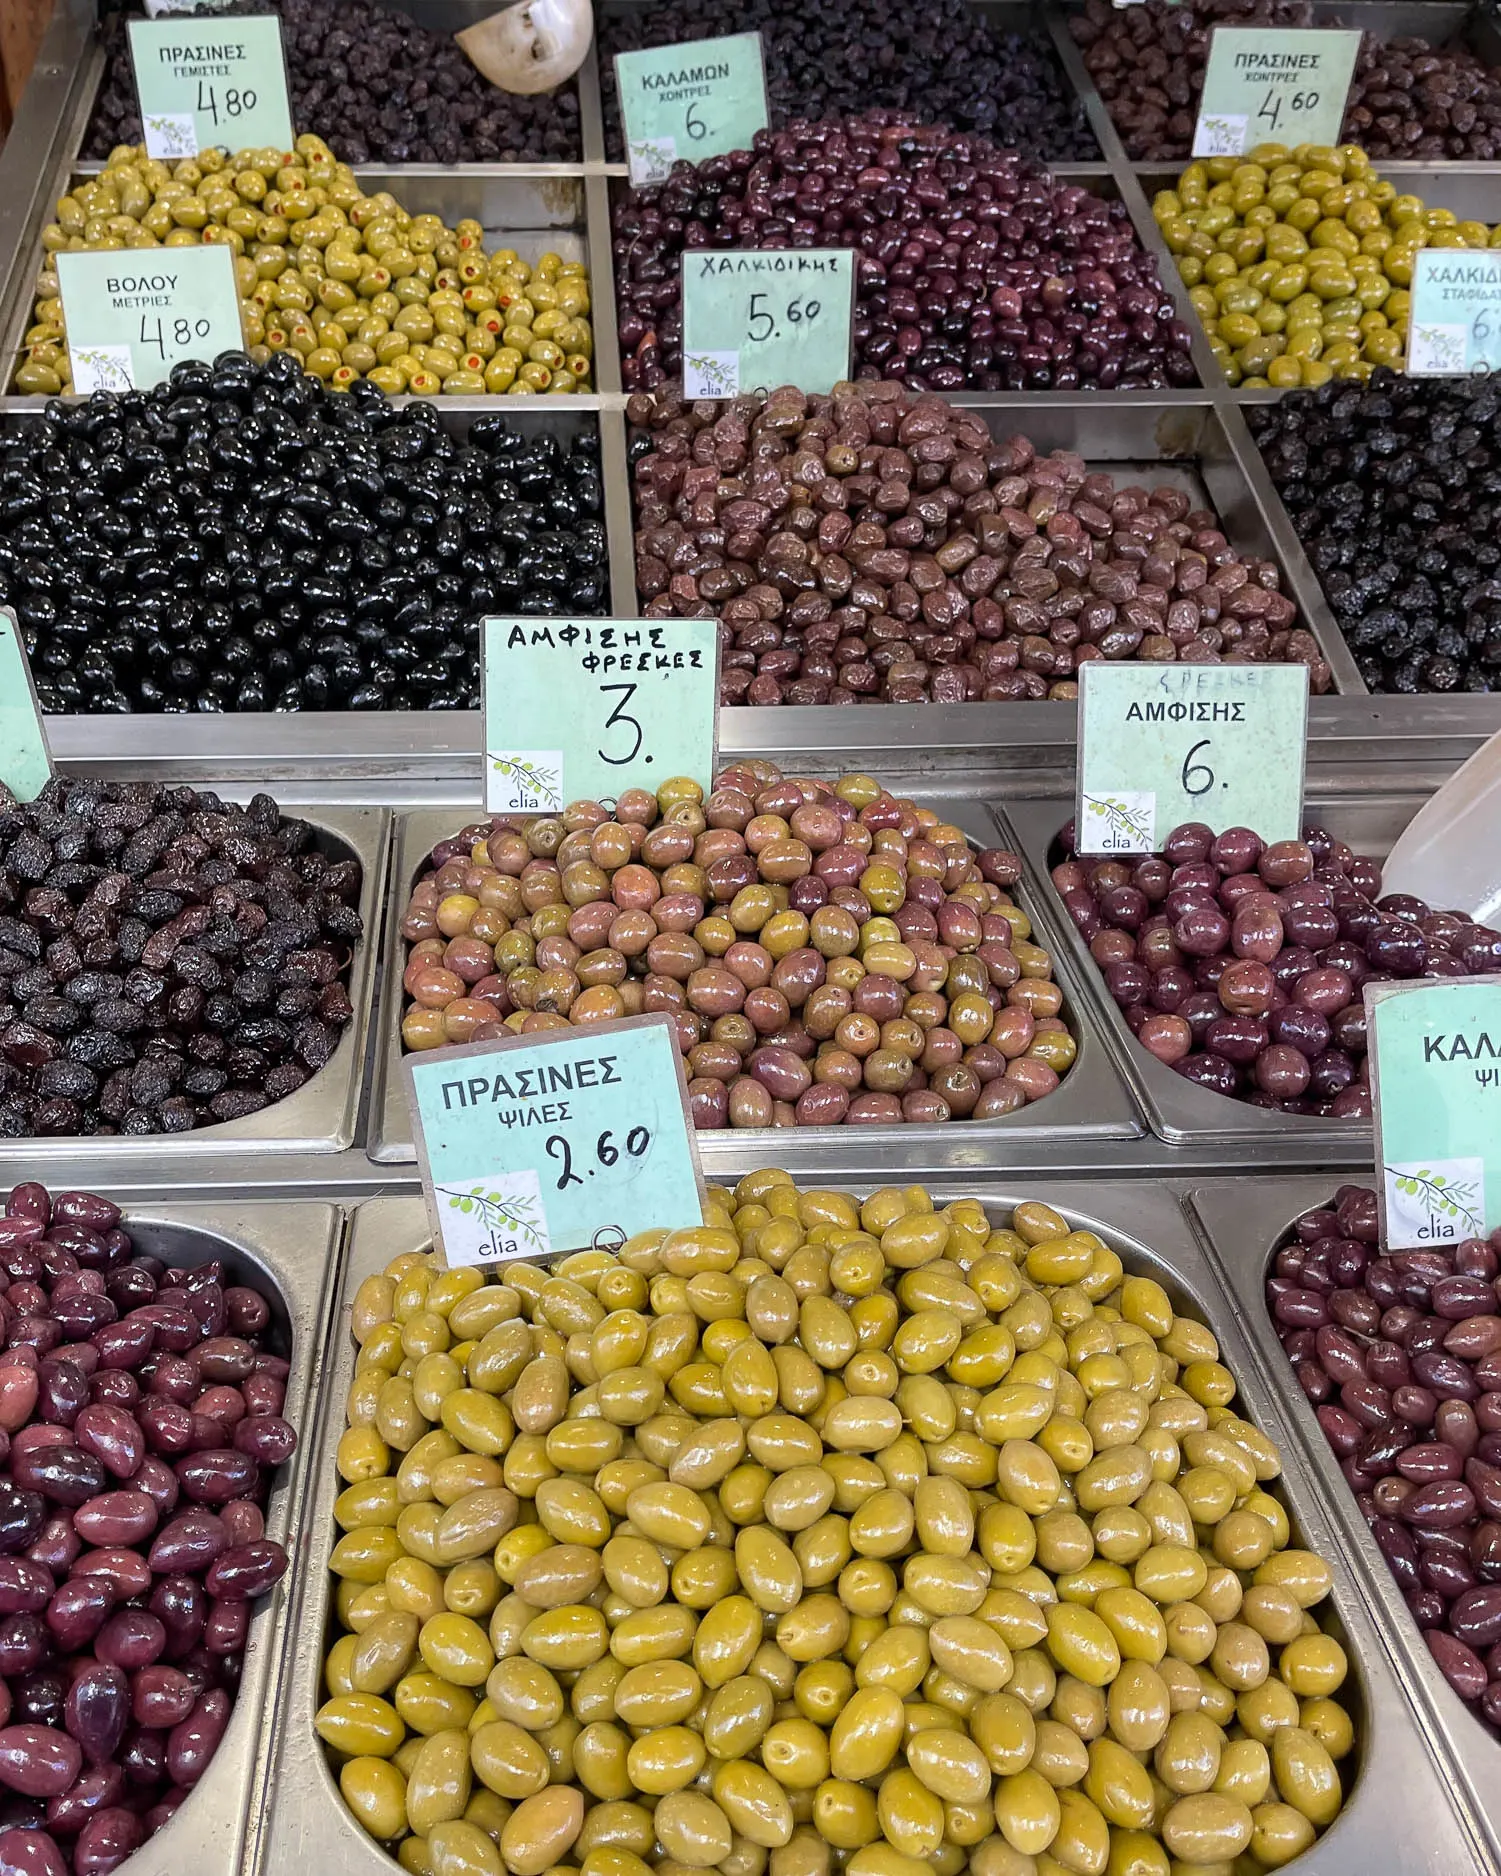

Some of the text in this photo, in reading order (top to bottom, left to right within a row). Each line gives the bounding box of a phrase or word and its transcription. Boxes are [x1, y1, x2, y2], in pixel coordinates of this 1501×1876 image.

[159, 44, 247, 63] ΠΡΑΣΙΝΕΣ
[1234, 53, 1321, 69] ΠΡΑΣΙΝΕΣ
[173, 64, 232, 78] ΓΕΜΙΣΤΕΣ
[642, 62, 730, 91] ΚΑΛΑΜΩΝ
[197, 80, 257, 127] 4.80
[659, 85, 713, 103] ΧΟΝΤΡΕΣ
[1257, 88, 1320, 131] 4.60
[700, 256, 839, 279] ΧΑΛΚΙΔΙΚΗΣ
[1427, 266, 1501, 284] ΧΑΛΚΙΔ
[106, 274, 178, 293] ΒΟΛΟΥ
[112, 295, 173, 309] ΜΕΤΡΙΕΣ
[748, 293, 821, 342] 5.60
[140, 314, 211, 360] 4.80
[700, 382, 722, 396] elia
[507, 624, 667, 649] ΑΜΦΙΣΗΣ
[582, 649, 704, 674] ΦΡΕΣΚΕΣ
[1125, 702, 1246, 722] ΑΜΦΙΣΗΣ
[508, 790, 539, 808] elia
[1102, 829, 1131, 849] elia
[1423, 1031, 1501, 1063] ΚΑΛ
[441, 1055, 622, 1110] ΠΡΑΣΙΝΕΣ
[498, 1101, 573, 1130] ΨΙΛΕΣ
[545, 1125, 651, 1190] 2.60
[1416, 1213, 1455, 1240] elia
[478, 1230, 519, 1257] elia
